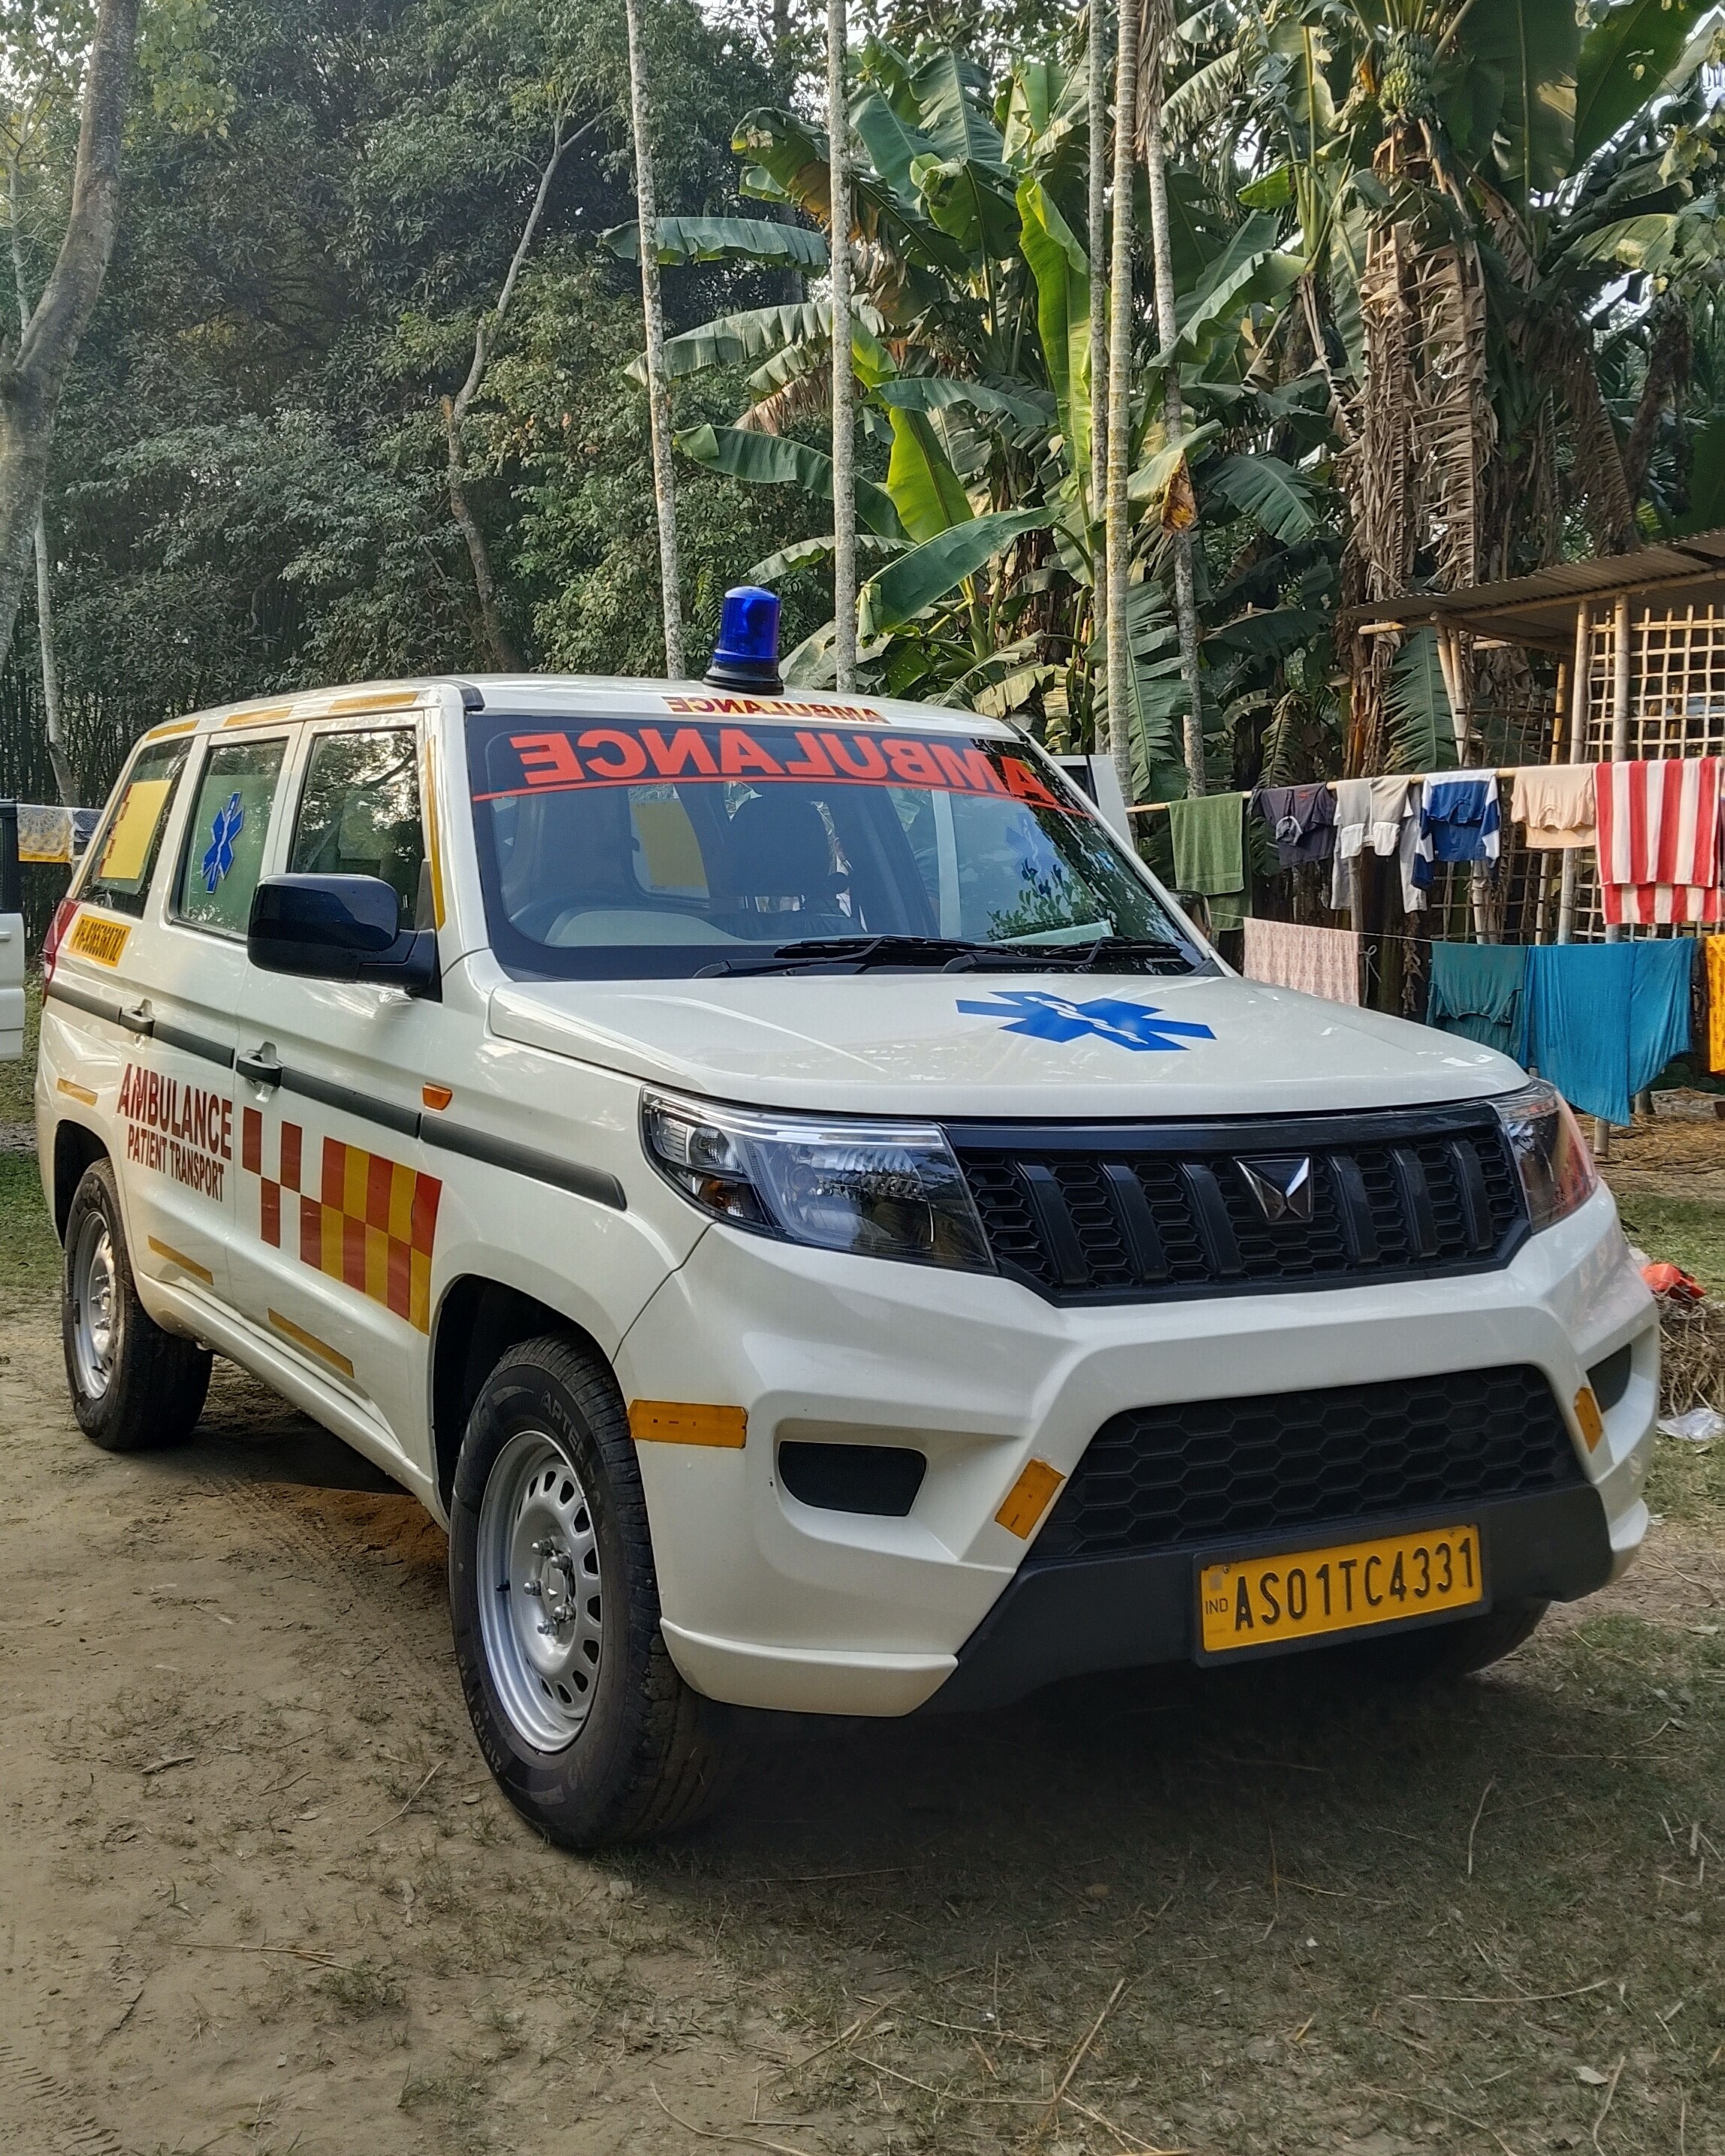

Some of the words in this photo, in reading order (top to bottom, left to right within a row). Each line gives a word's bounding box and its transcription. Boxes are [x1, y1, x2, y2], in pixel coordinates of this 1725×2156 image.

[116, 1062, 233, 1161] AMBULANCE
[127, 1123, 168, 1174] PATIENT
[169, 1140, 225, 1203] TRANSPORT
[1205, 1597, 1228, 1616] IND
[1234, 1537, 1475, 1632] AS01TC4331
